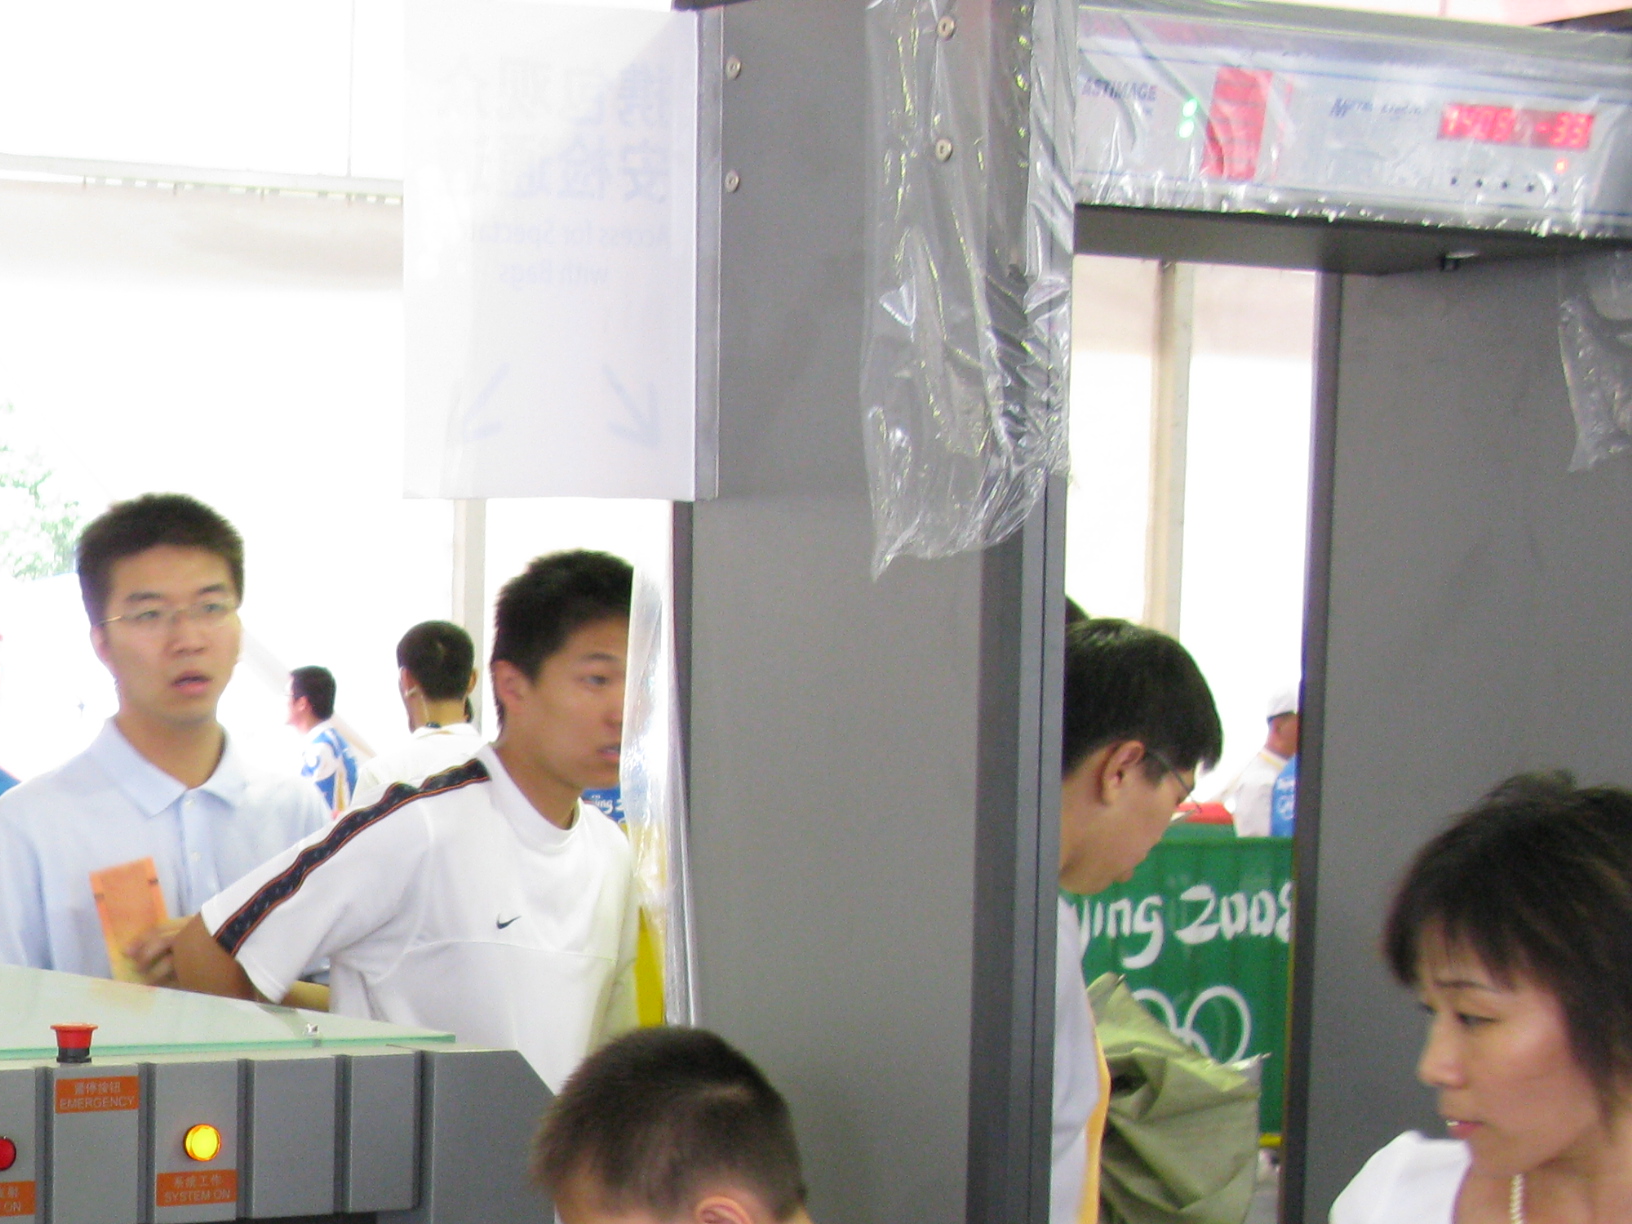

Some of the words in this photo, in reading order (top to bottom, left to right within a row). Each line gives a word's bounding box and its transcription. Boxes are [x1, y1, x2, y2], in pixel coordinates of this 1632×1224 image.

[1075, 895, 1165, 969] jing
[60, 1096, 135, 1109] EMERGENCY
[164, 1190, 211, 1202] SYSTEM
[214, 1188, 231, 1200] ON
[4, 1201, 21, 1212] ON
